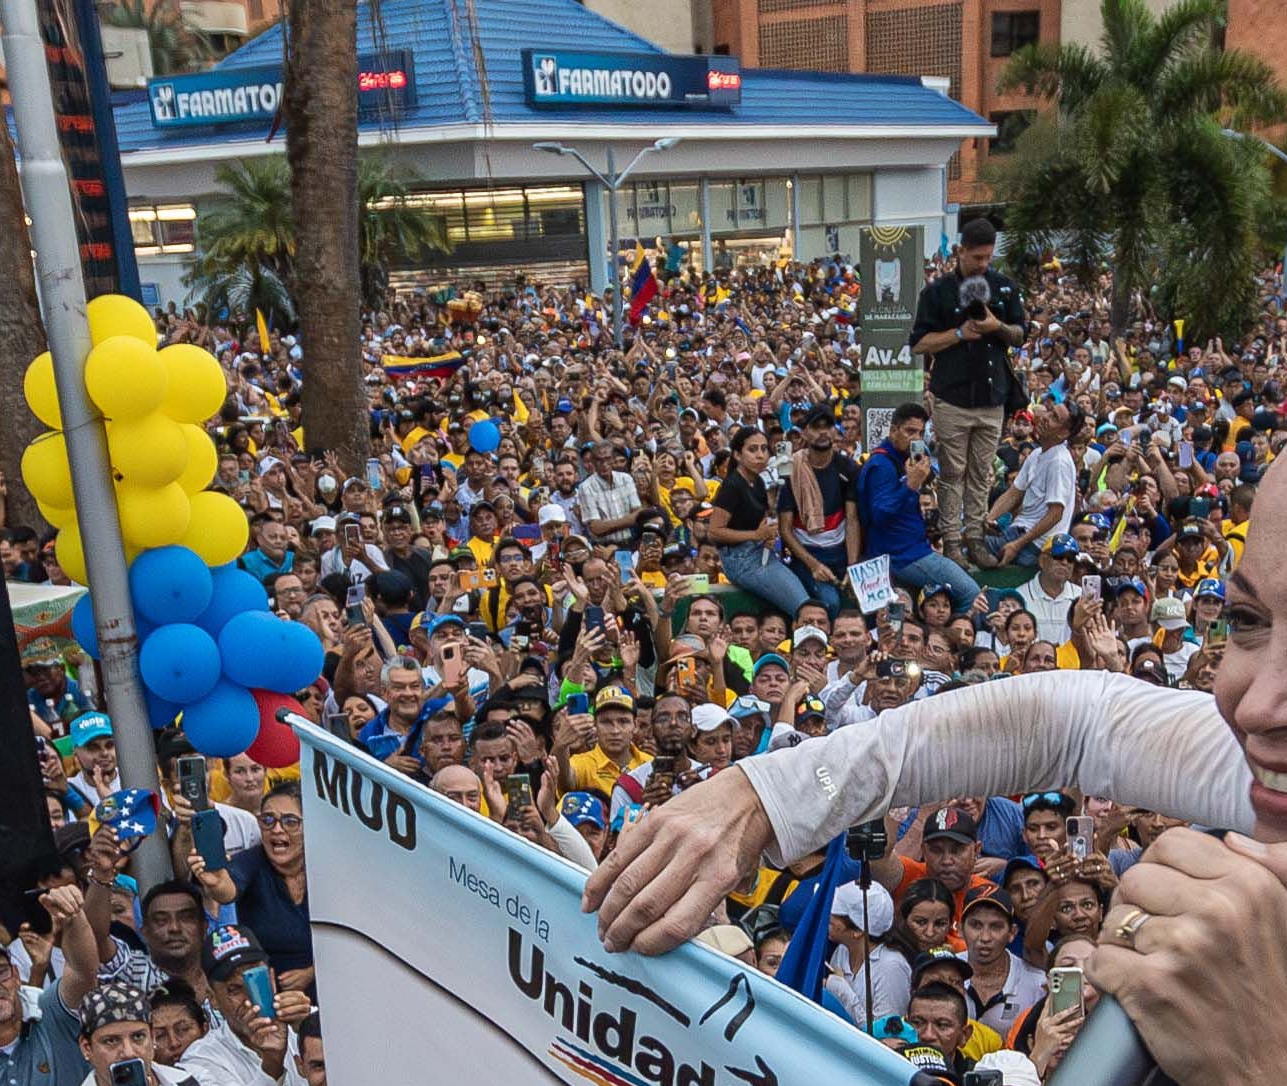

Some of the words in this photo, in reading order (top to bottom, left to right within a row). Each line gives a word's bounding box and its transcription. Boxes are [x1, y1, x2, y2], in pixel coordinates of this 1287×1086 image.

[176, 82, 284, 119] FARMATO
[559, 67, 671, 98] FARMATODO
[864, 344, 912, 366] Av.4
[314, 748, 417, 852] MUD
[449, 855, 501, 910] Mesa
[506, 895, 532, 926] de
[534, 909, 550, 943] la
